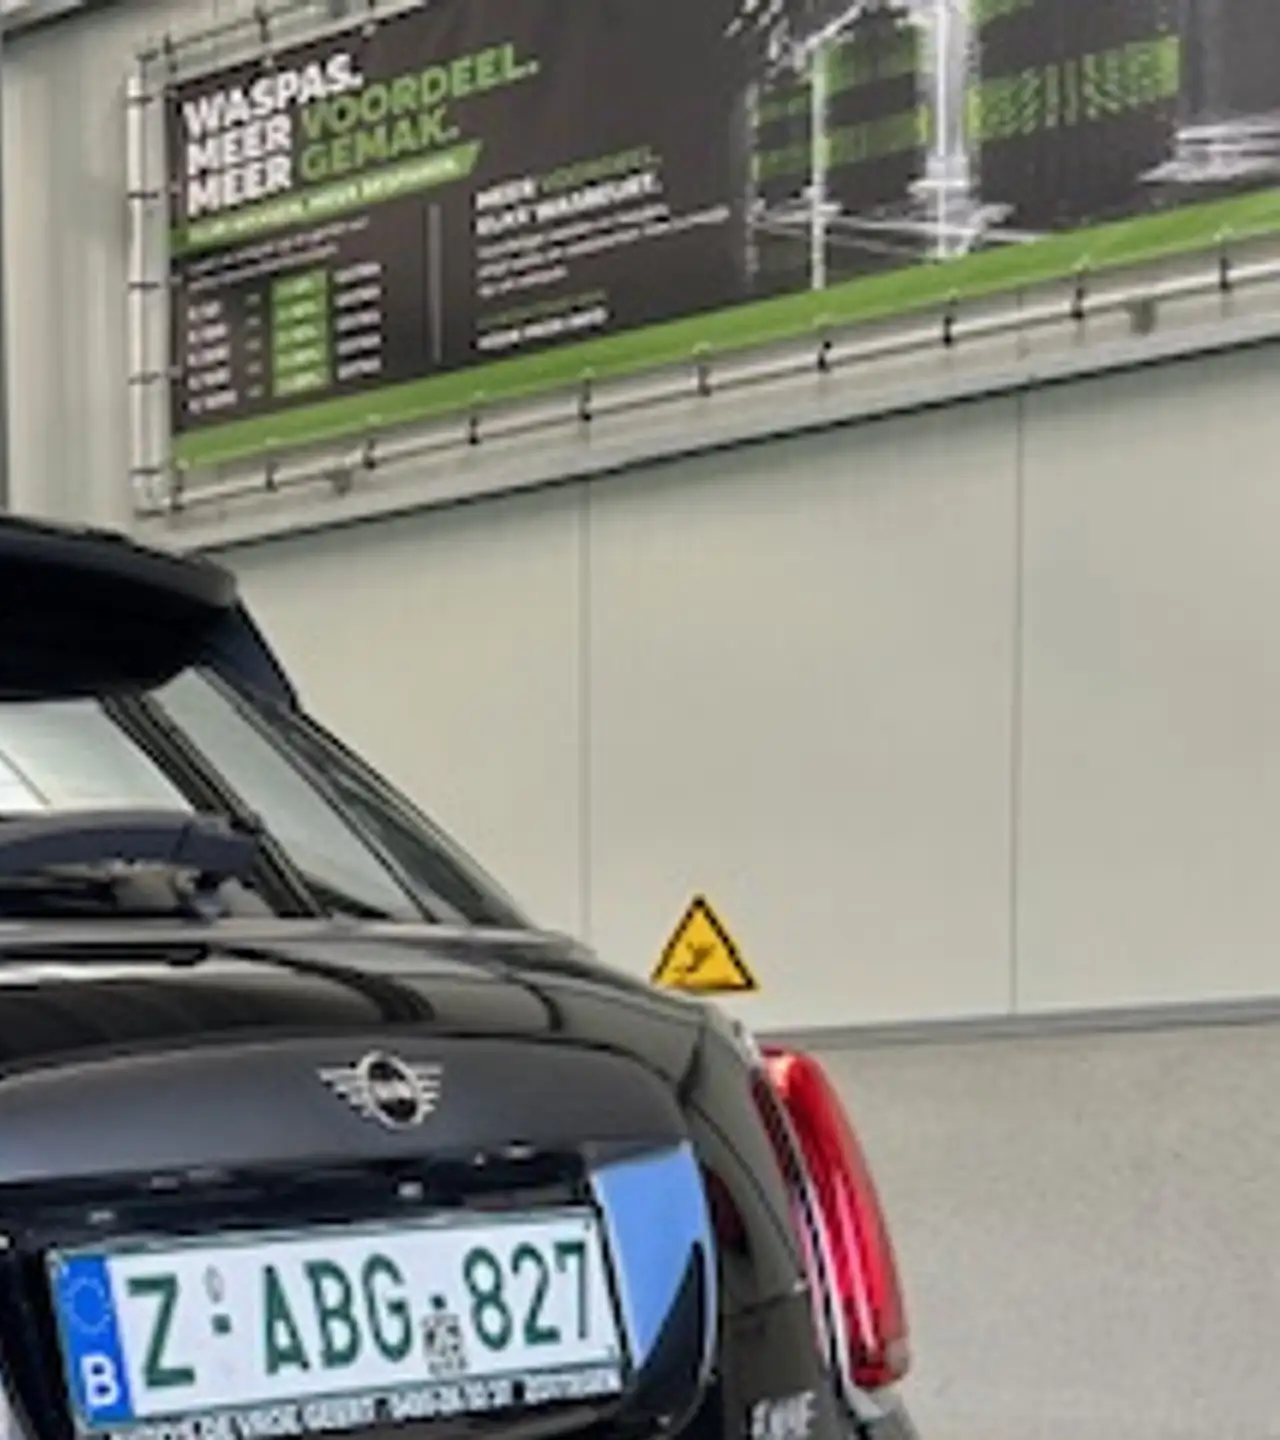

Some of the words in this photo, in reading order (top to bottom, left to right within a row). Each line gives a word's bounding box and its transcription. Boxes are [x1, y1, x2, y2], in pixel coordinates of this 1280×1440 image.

[184, 54, 364, 137] WASPAS.
[187, 115, 292, 176] MEER
[301, 43, 539, 138] VOORDEEL.
[187, 156, 293, 217] MEER
[300, 106, 461, 180] GEMAK.
[80, 1354, 123, 1407] B
